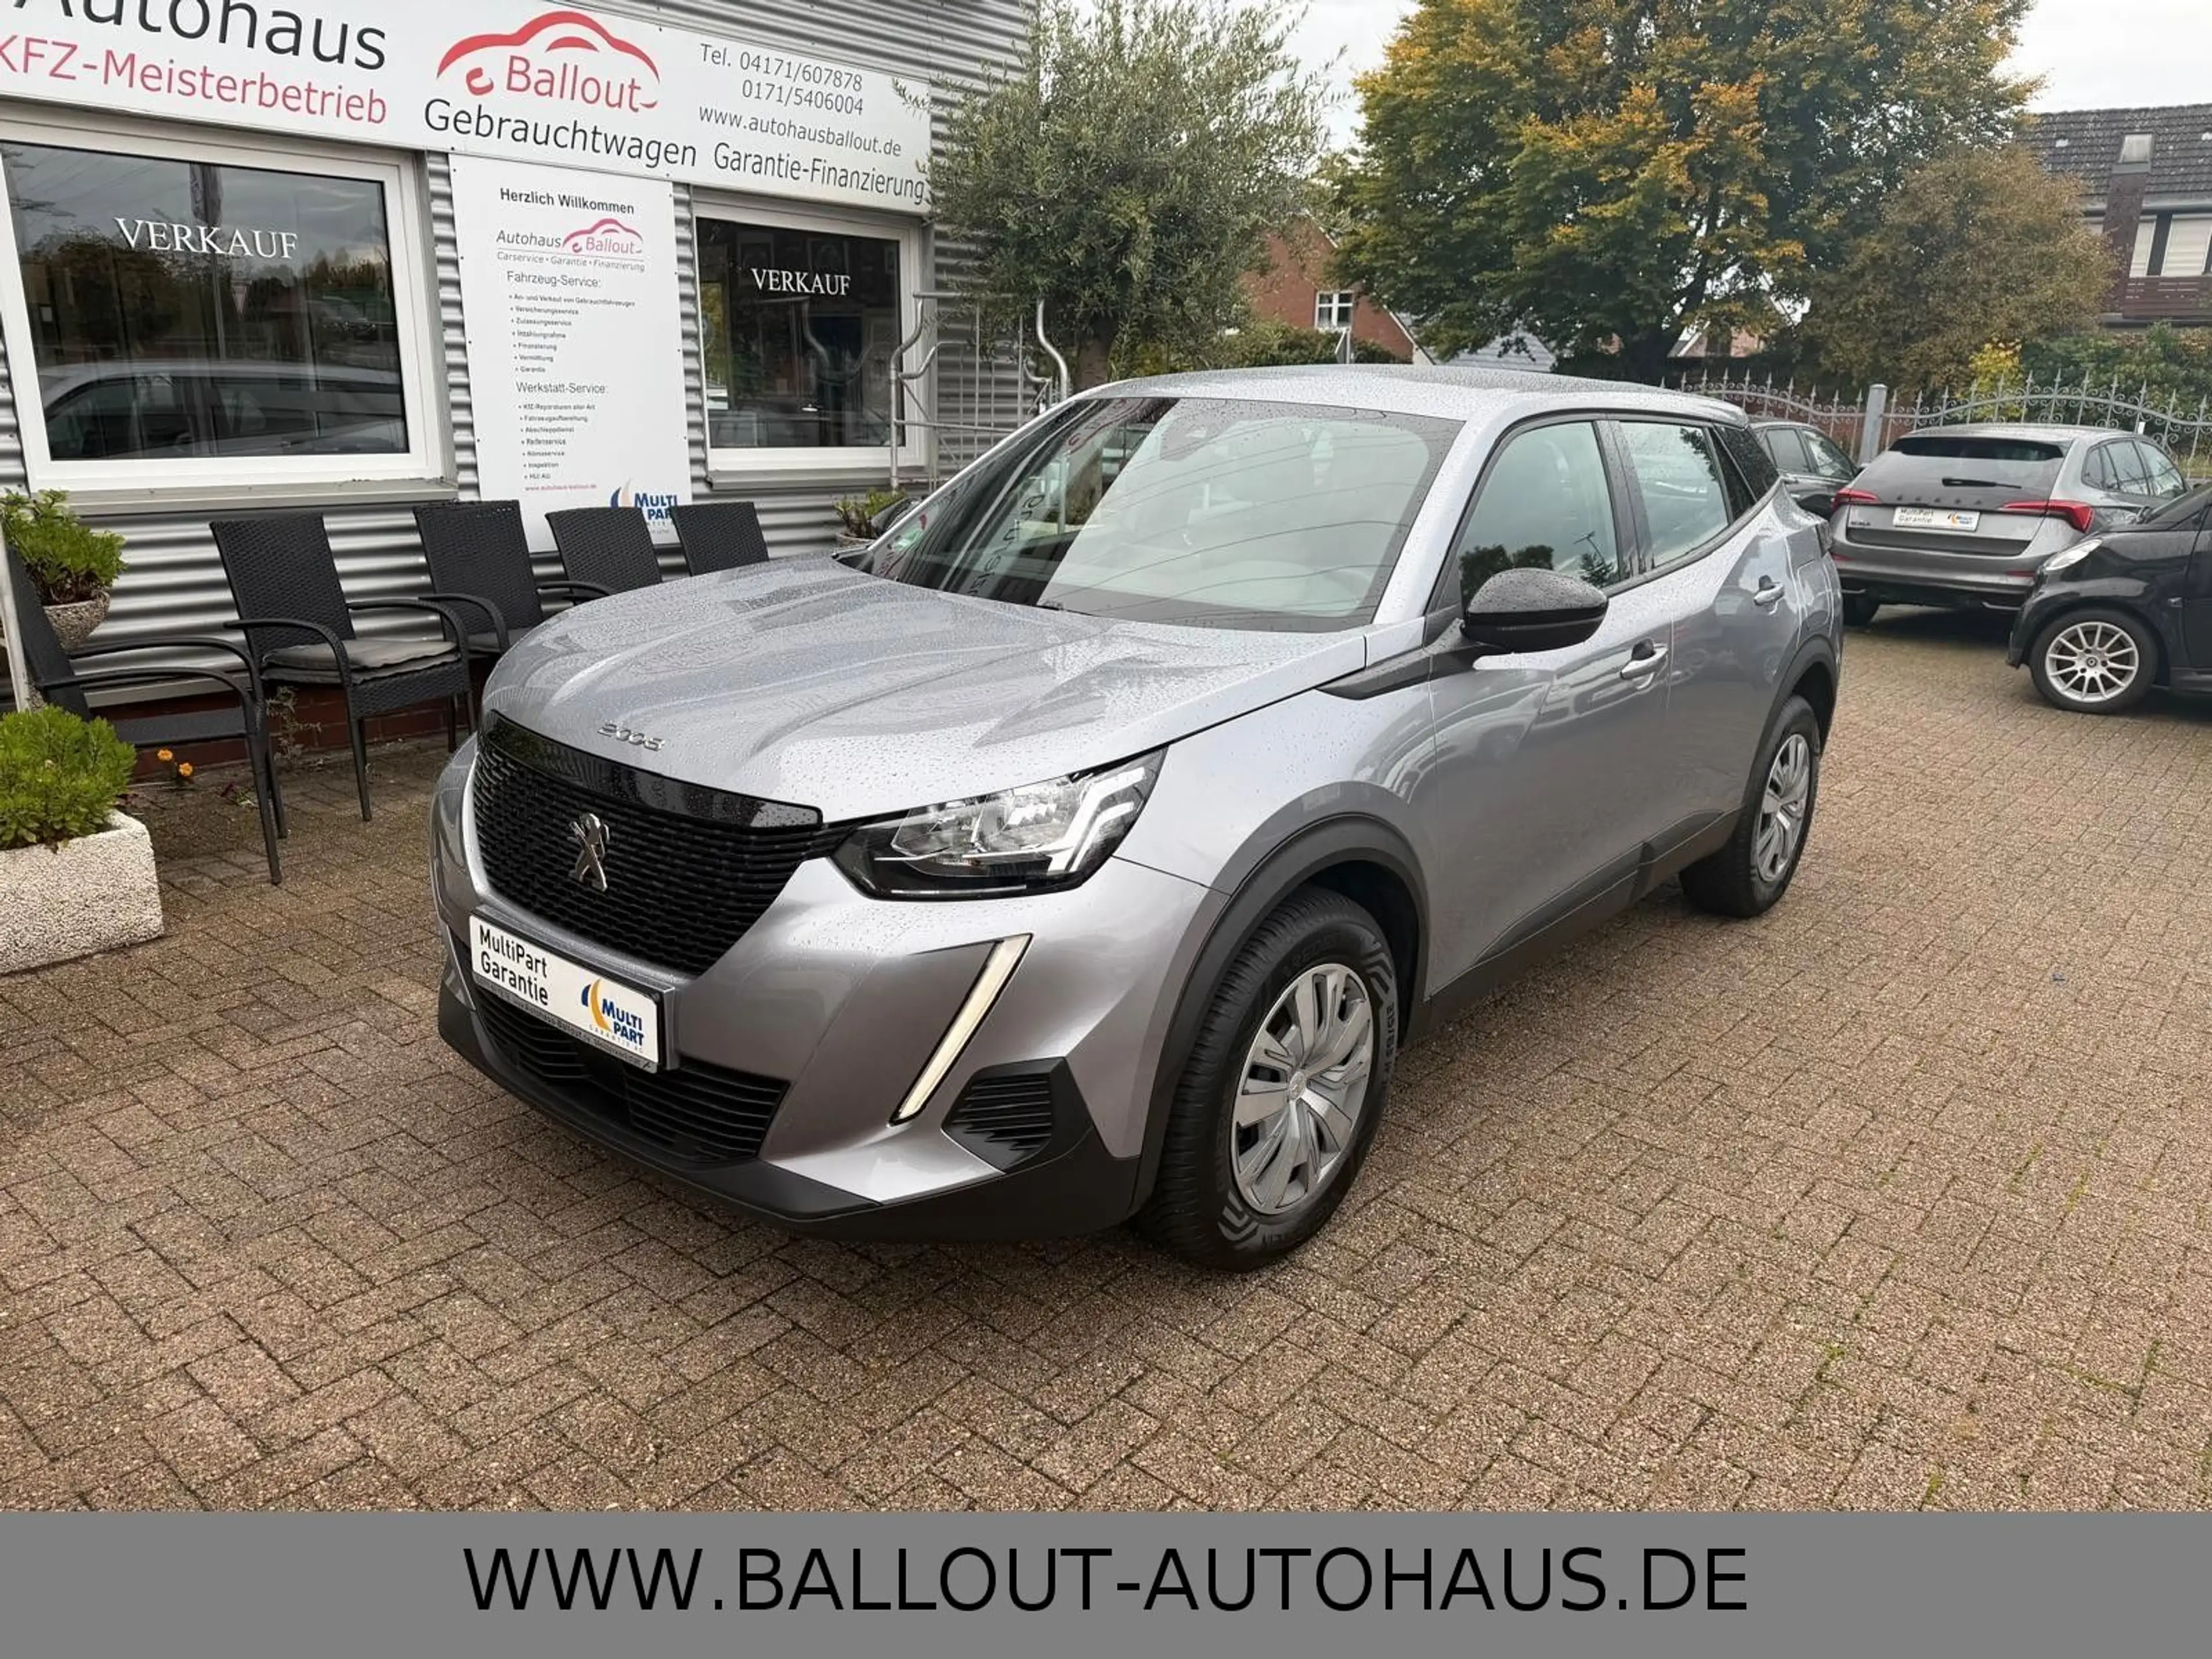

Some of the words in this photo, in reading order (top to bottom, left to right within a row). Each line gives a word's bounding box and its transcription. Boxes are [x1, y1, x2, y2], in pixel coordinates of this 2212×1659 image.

[14, 0, 385, 70] utohaus
[0, 35, 387, 124] KFZ-Meisterbetrieb
[506, 56, 641, 112] Ballout
[700, 44, 732, 68] Tel.
[740, 52, 862, 92] 04171/607878
[742, 80, 863, 115] 0171/5406004
[425, 99, 696, 168] Gebrauchtwagen
[699, 104, 902, 157] www.autohausballout.de
[714, 142, 924, 205] Garantie-Finanzierung
[500, 187, 554, 206] Herzlich
[558, 194, 634, 214] Willkommen
[115, 217, 298, 259] VERKAUF
[497, 230, 561, 248] Autohaus
[586, 236, 634, 254] Ballout
[497, 251, 544, 263] Carservice
[551, 256, 586, 267] Garantie
[594, 259, 645, 272] Finanzierung
[507, 271, 601, 287] Fahrzeug-Service:
[750, 267, 851, 296] VERKAUF
[516, 381, 608, 394] Werkstatt-Service:
[634, 493, 678, 507] MULTI
[479, 925, 547, 978] MultiPart
[480, 950, 548, 1006] Garantie
[603, 998, 642, 1031] MULTI
[614, 1021, 644, 1046] PART
